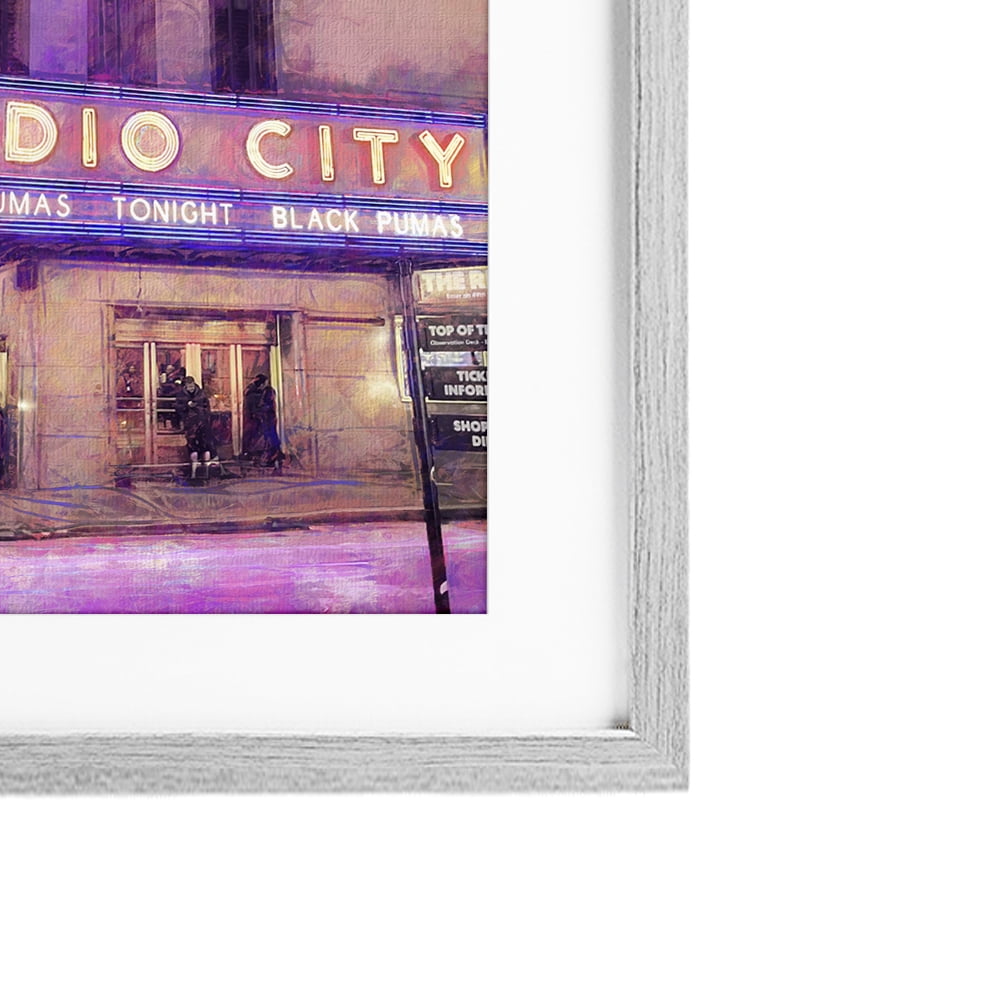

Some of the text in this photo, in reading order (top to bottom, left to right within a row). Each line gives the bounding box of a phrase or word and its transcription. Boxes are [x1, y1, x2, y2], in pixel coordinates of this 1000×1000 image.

[246, 119, 466, 189] CITY
[112, 196, 234, 226] TONIGHT
[271, 205, 360, 233] BLACK
[376, 210, 465, 238] PUMAS
[421, 271, 466, 292] THE
[428, 325, 455, 337] TOP
[456, 324, 475, 337] OF
